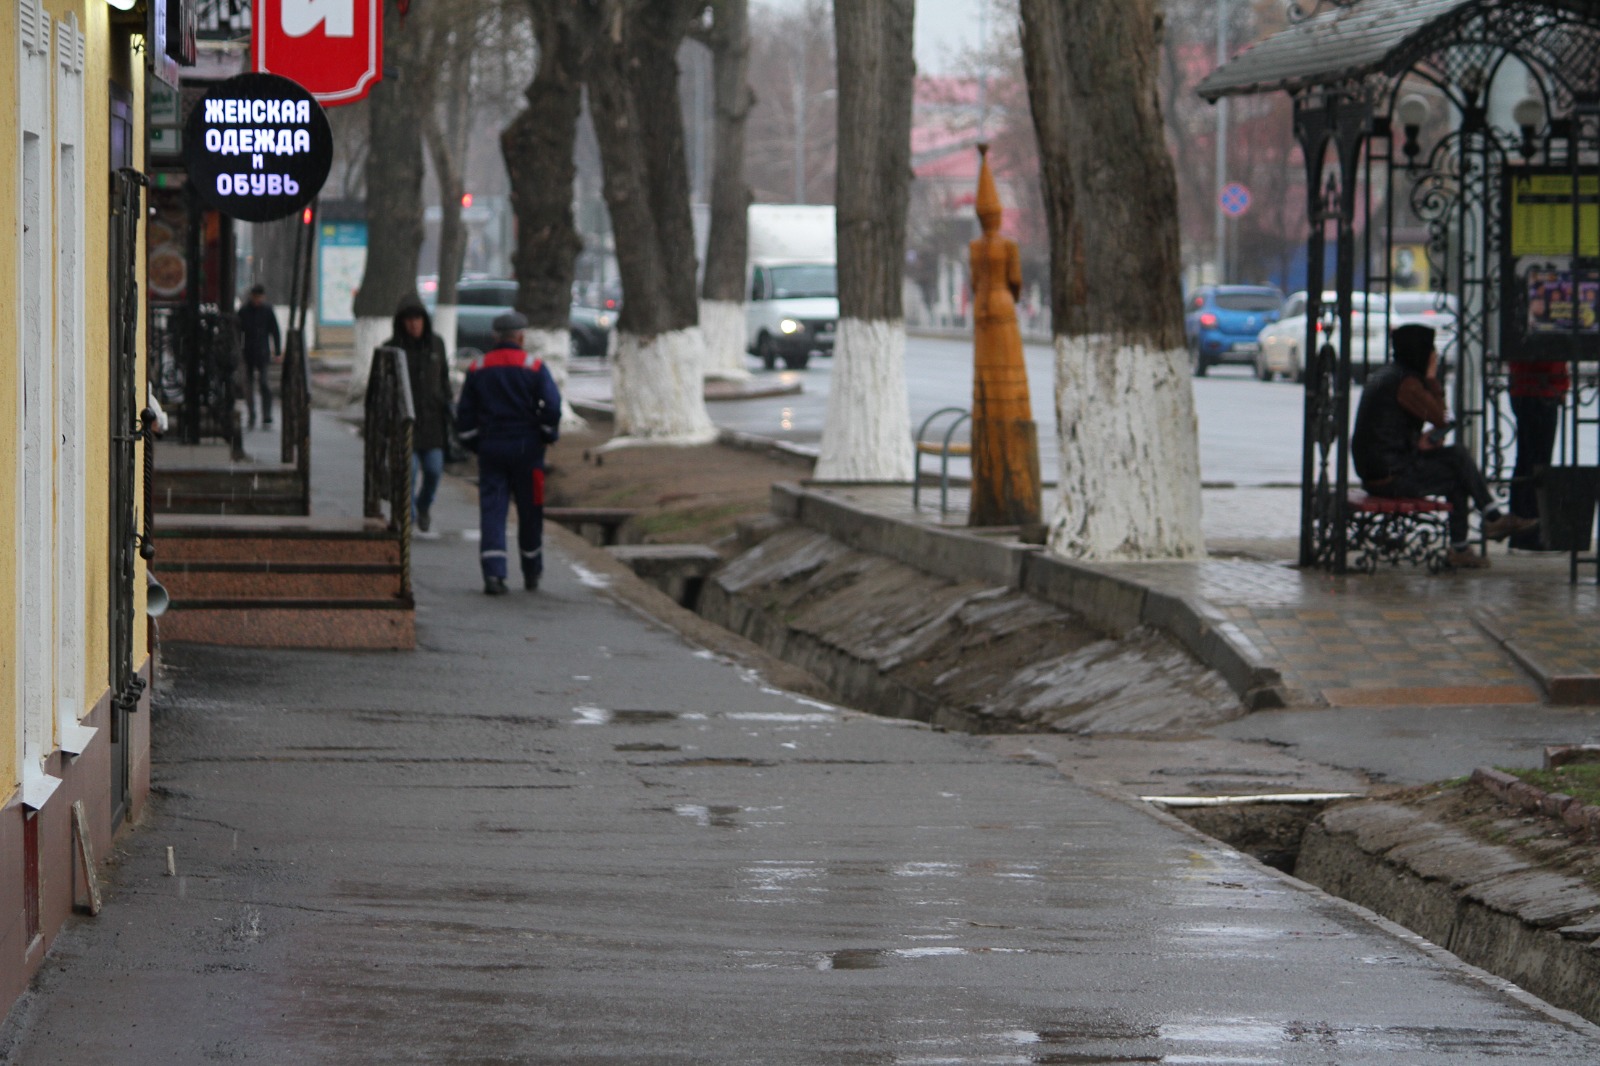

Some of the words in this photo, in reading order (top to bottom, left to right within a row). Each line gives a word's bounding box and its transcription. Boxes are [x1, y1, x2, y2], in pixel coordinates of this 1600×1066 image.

[205, 99, 310, 124] ЖЕНСКАЯ
[205, 129, 310, 156] ОДЕЖДА
[216, 173, 300, 196] ОБУВЬ
